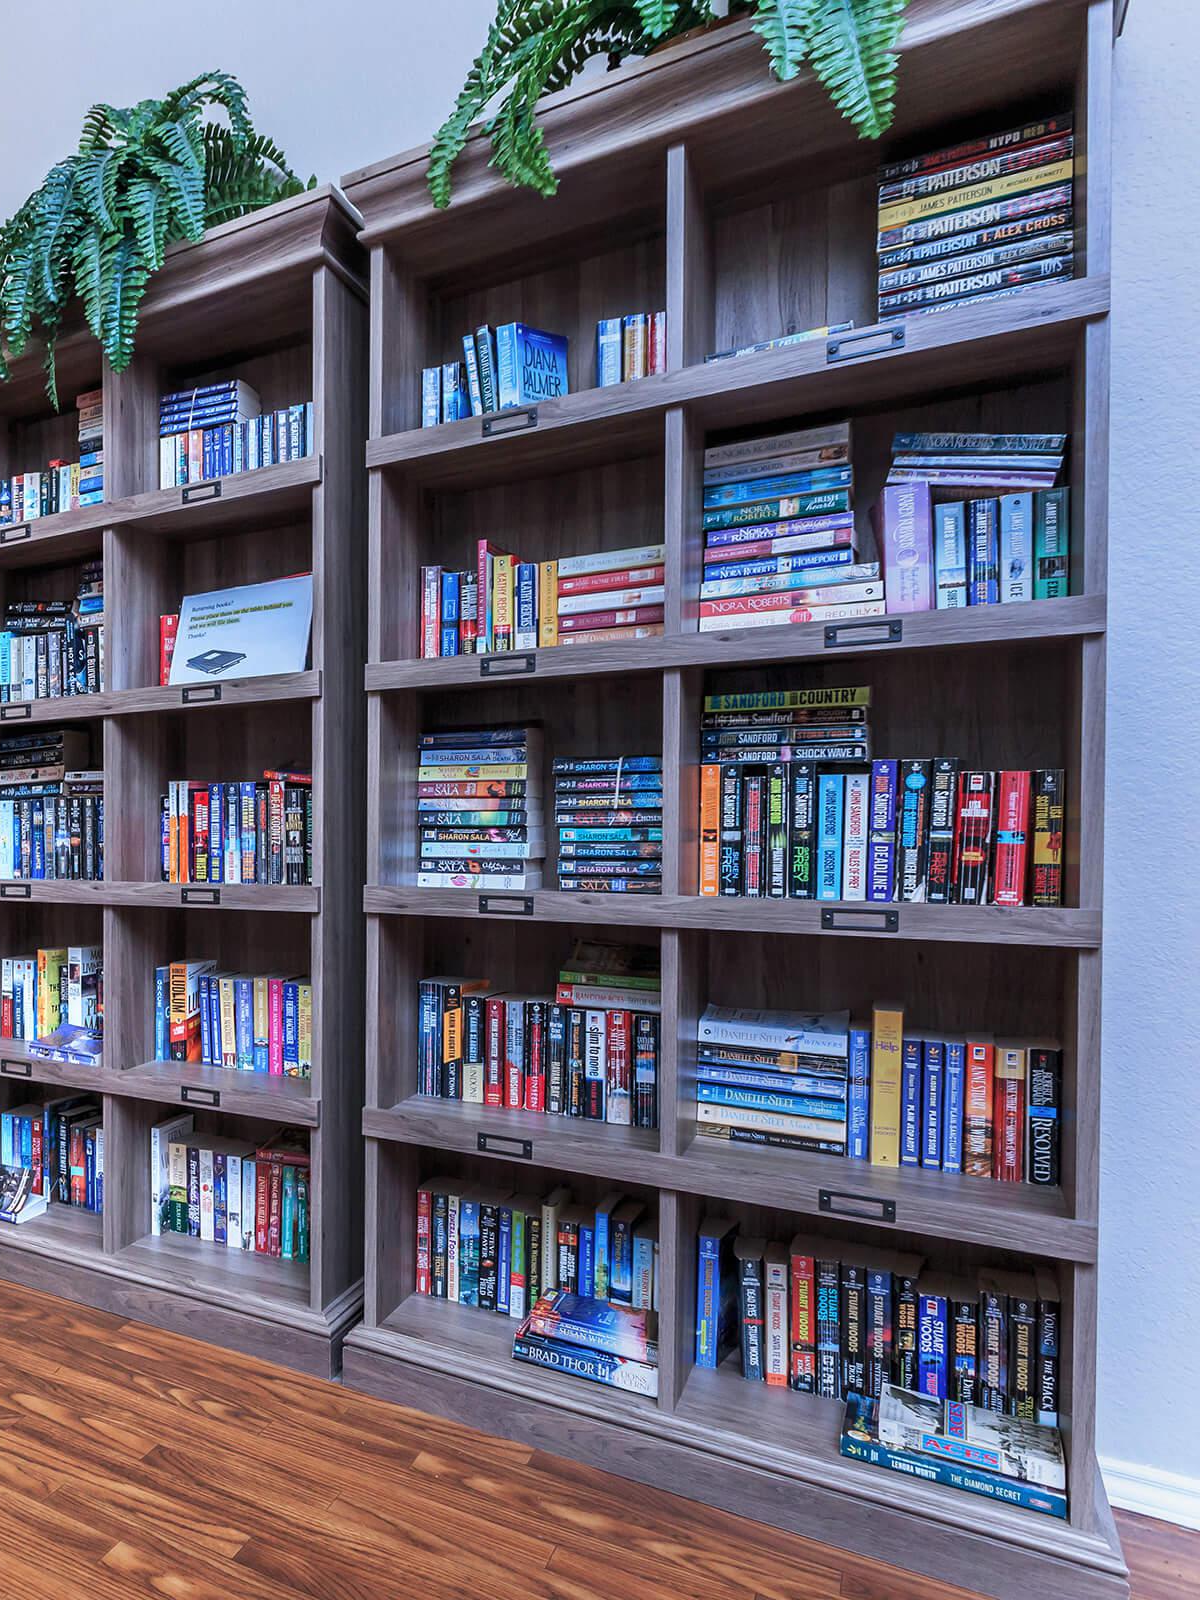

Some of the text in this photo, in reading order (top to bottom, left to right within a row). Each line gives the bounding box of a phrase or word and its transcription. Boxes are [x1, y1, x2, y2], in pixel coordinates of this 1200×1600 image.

[935, 259, 1063, 296] PATTERSON TOYS
[524, 341, 558, 374] DIANA
[523, 367, 561, 398] PALMER
[733, 510, 778, 522] ROBERTS
[740, 504, 770, 514] NORA
[732, 532, 774, 541] ROBERTS
[739, 527, 769, 536] NORA
[1045, 503, 1057, 553] JAMES ROLLINS
[720, 554, 838, 579] NORA ROBERTS HOMEPORT
[497, 573, 507, 623] KATHY REICHS
[711, 595, 790, 613] NORA ROBERTS
[724, 689, 857, 709] SANDFORD COUNTRY
[727, 712, 793, 725] John Sandford
[738, 751, 777, 761] SANDFORD
[796, 749, 826, 759] SHOCK
[828, 748, 853, 758] WAVE
[435, 787, 459, 796] SALA
[724, 778, 736, 794] JOHN
[849, 789, 860, 805] JOHN
[933, 772, 948, 826] JOHN SANDFORD
[271, 794, 280, 845] DEAN KOONTZ
[437, 816, 461, 825] SALA
[723, 795, 736, 827] SANDFORD
[849, 806, 860, 836] SANDFORD
[1035, 795, 1047, 829] SCOTTOLINE
[1049, 806, 1062, 818] LISA
[770, 778, 783, 887] JOHN SANDFORD PHANTOM PREY
[824, 789, 836, 887] JOHN SANDFORD CHOSEN PREY
[873, 776, 888, 890] JOHN SANDFORD DEADLINE
[437, 864, 466, 872] SALA
[722, 847, 731, 883] PREY
[793, 847, 804, 881] PREY
[849, 850, 860, 867] RULES
[849, 876, 860, 890] PREY
[171, 974, 185, 1013] LUDLUM
[448, 1012, 456, 1028] KARIN
[448, 1029, 456, 1059] SLAUGHTER
[721, 1028, 842, 1049] DANIELLE STEEL WINNERS
[876, 1041, 898, 1053] Help
[720, 1051, 774, 1065] DANIELLE STEEL
[725, 1088, 793, 1108] DANIELLE STEEL
[970, 1066, 986, 1153] ANNE STUART THE WIDOW
[720, 1109, 759, 1125] DANIELLE
[761, 1114, 785, 1128] STEEL
[1032, 1118, 1051, 1181] RESOLVED
[481, 1228, 489, 1258] THAYER
[559, 1246, 567, 1281] WAMBAUGH
[799, 1280, 809, 1340] STUART WOODS
[818, 1288, 827, 1320] WOODS
[828, 1288, 837, 1322] STUART
[907, 1304, 915, 1328] STUART
[560, 1328, 586, 1341] SUSAN
[849, 1290, 858, 1352] STUART WOODS
[874, 1295, 883, 1358] STUART WOODS
[921, 1316, 932, 1353] WOODS
[933, 1321, 944, 1354] STUART
[956, 1323, 965, 1354] WOODS
[966, 1324, 975, 1355] STUART
[987, 1318, 998, 1388] STUART WOODS
[528, 1347, 594, 1375] BRAD THOR
[1016, 1324, 1028, 1391] STUART WOODS
[1042, 1313, 1056, 1410] YOUNG THE SHACK
[823, 1355, 834, 1395] DIRT
[950, 1402, 965, 1437] ACES
[925, 1439, 998, 1464] ACES
